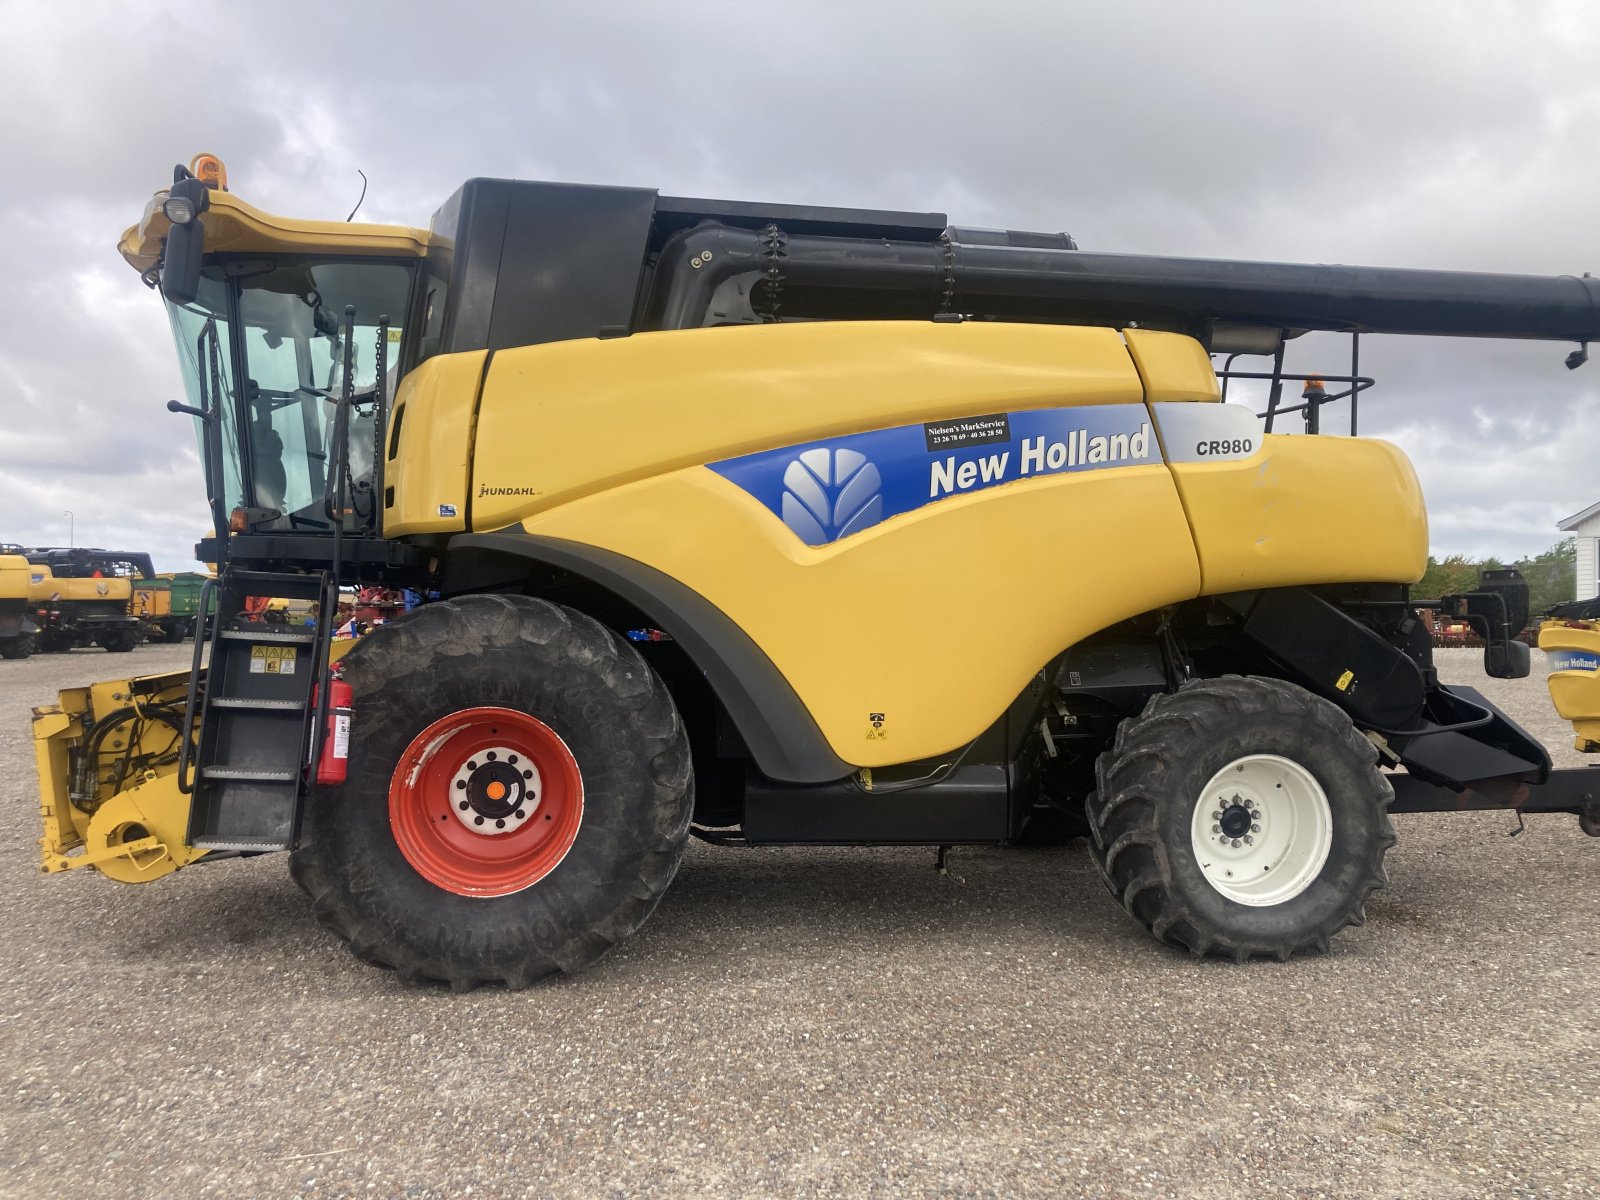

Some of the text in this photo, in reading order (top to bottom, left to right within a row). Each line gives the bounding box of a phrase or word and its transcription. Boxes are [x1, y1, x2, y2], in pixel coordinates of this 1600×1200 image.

[928, 420, 1006, 435] Nielsen's MarkService
[933, 436, 941, 444] 23
[942, 435, 950, 443] 26
[1196, 438, 1253, 456] CR980
[929, 423, 1149, 497] New Holland
[1554, 658, 1597, 669] New Holland
